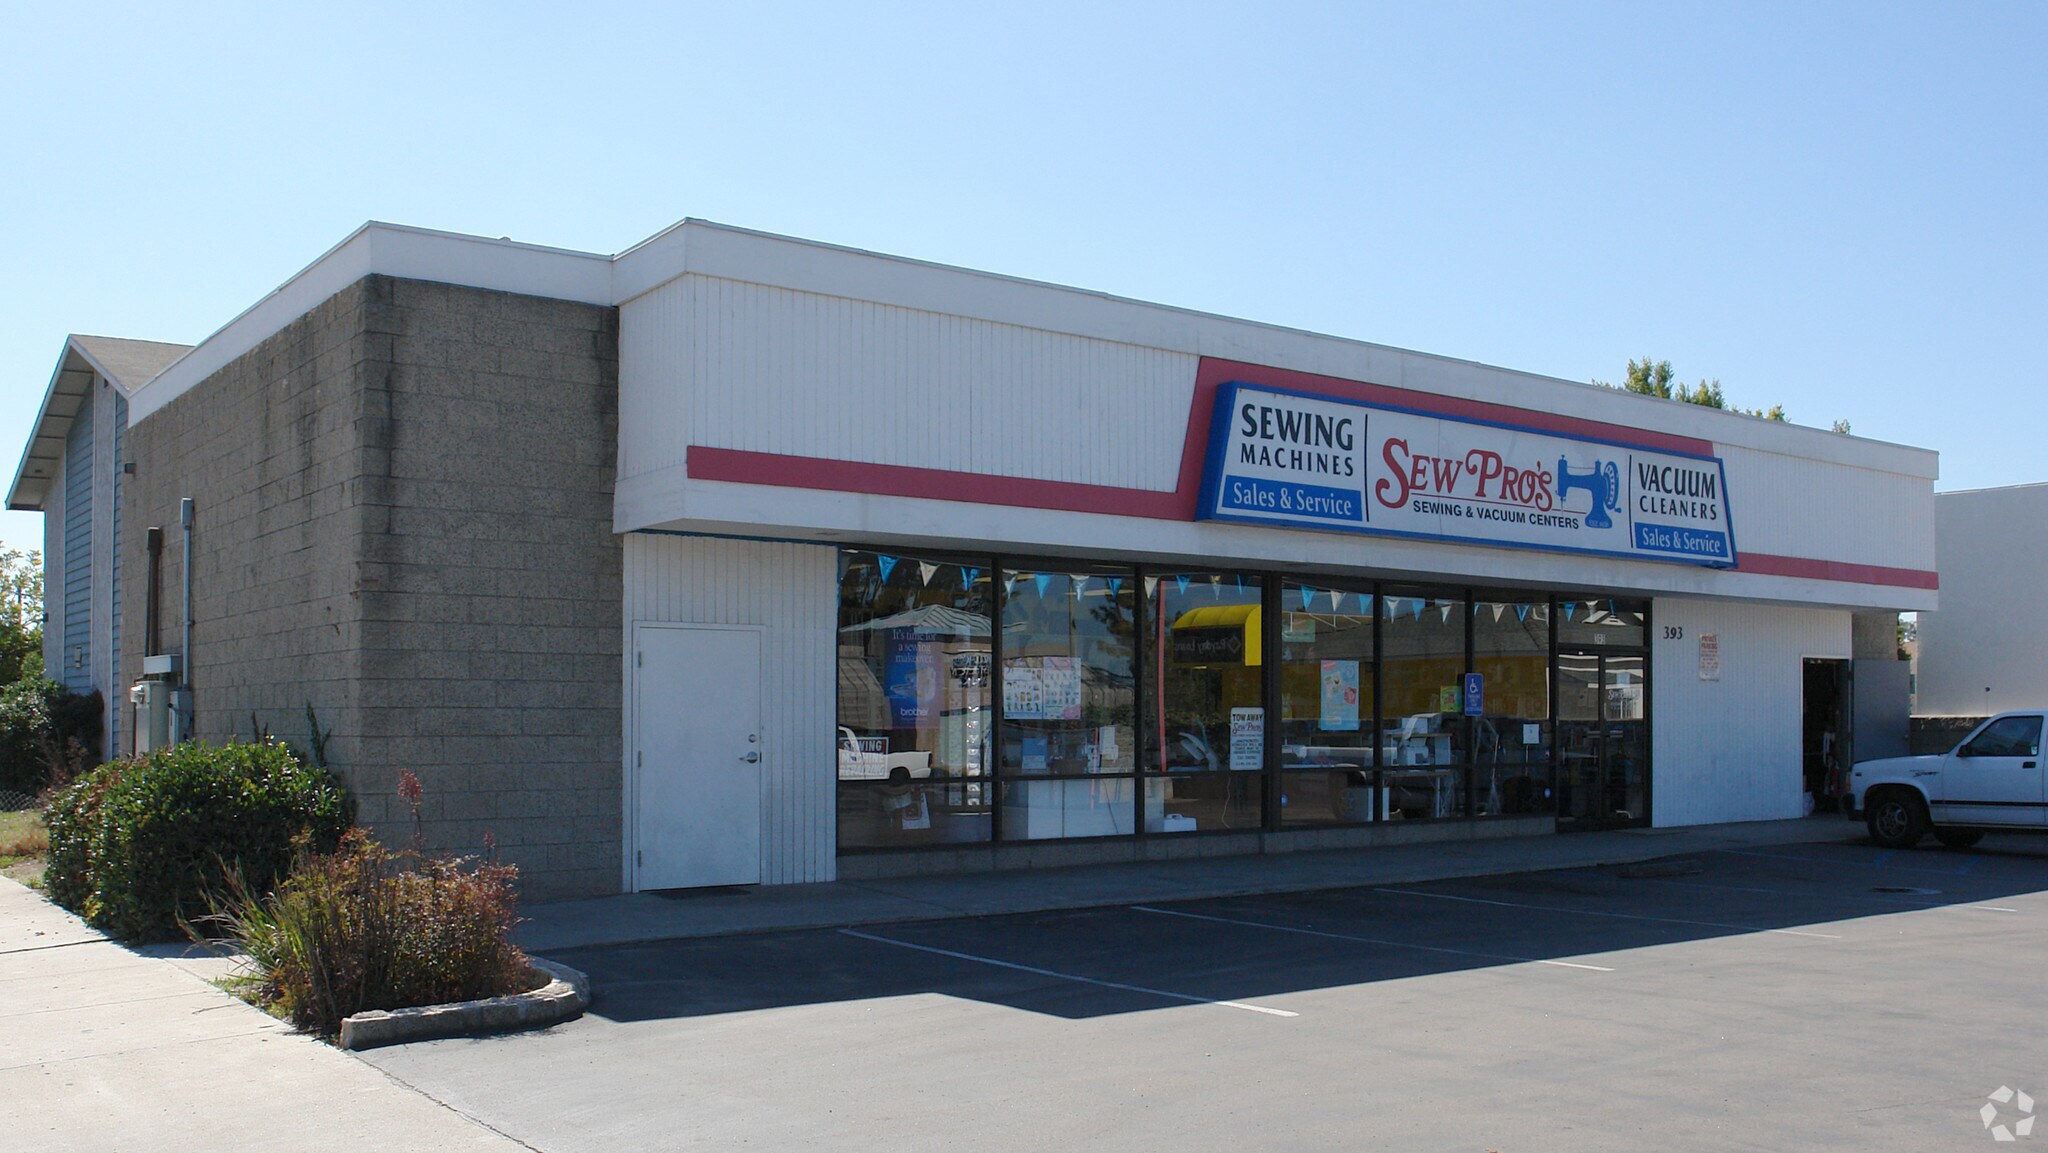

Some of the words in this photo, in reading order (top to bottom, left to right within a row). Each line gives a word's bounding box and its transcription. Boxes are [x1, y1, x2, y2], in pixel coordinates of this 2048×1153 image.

[1241, 403, 1353, 451] SEWING
[1240, 442, 1353, 477] MACHINES
[1375, 437, 1463, 509] SEW
[1638, 462, 1716, 500] VACUUM
[1233, 482, 1275, 508] Sales
[1280, 487, 1292, 509] &
[1296, 489, 1352, 515] Service
[1639, 495, 1717, 520] CLEANERS
[1413, 500, 1462, 517] SEWING
[1465, 506, 1474, 518] &
[1476, 507, 1526, 524] VACUUM
[1528, 512, 1579, 530] CENTERS
[1642, 527, 1671, 548] Sales
[1673, 530, 1681, 549] &
[1683, 532, 1720, 553] Service
[1663, 625, 1683, 640] 393
[900, 707, 929, 716] brother
